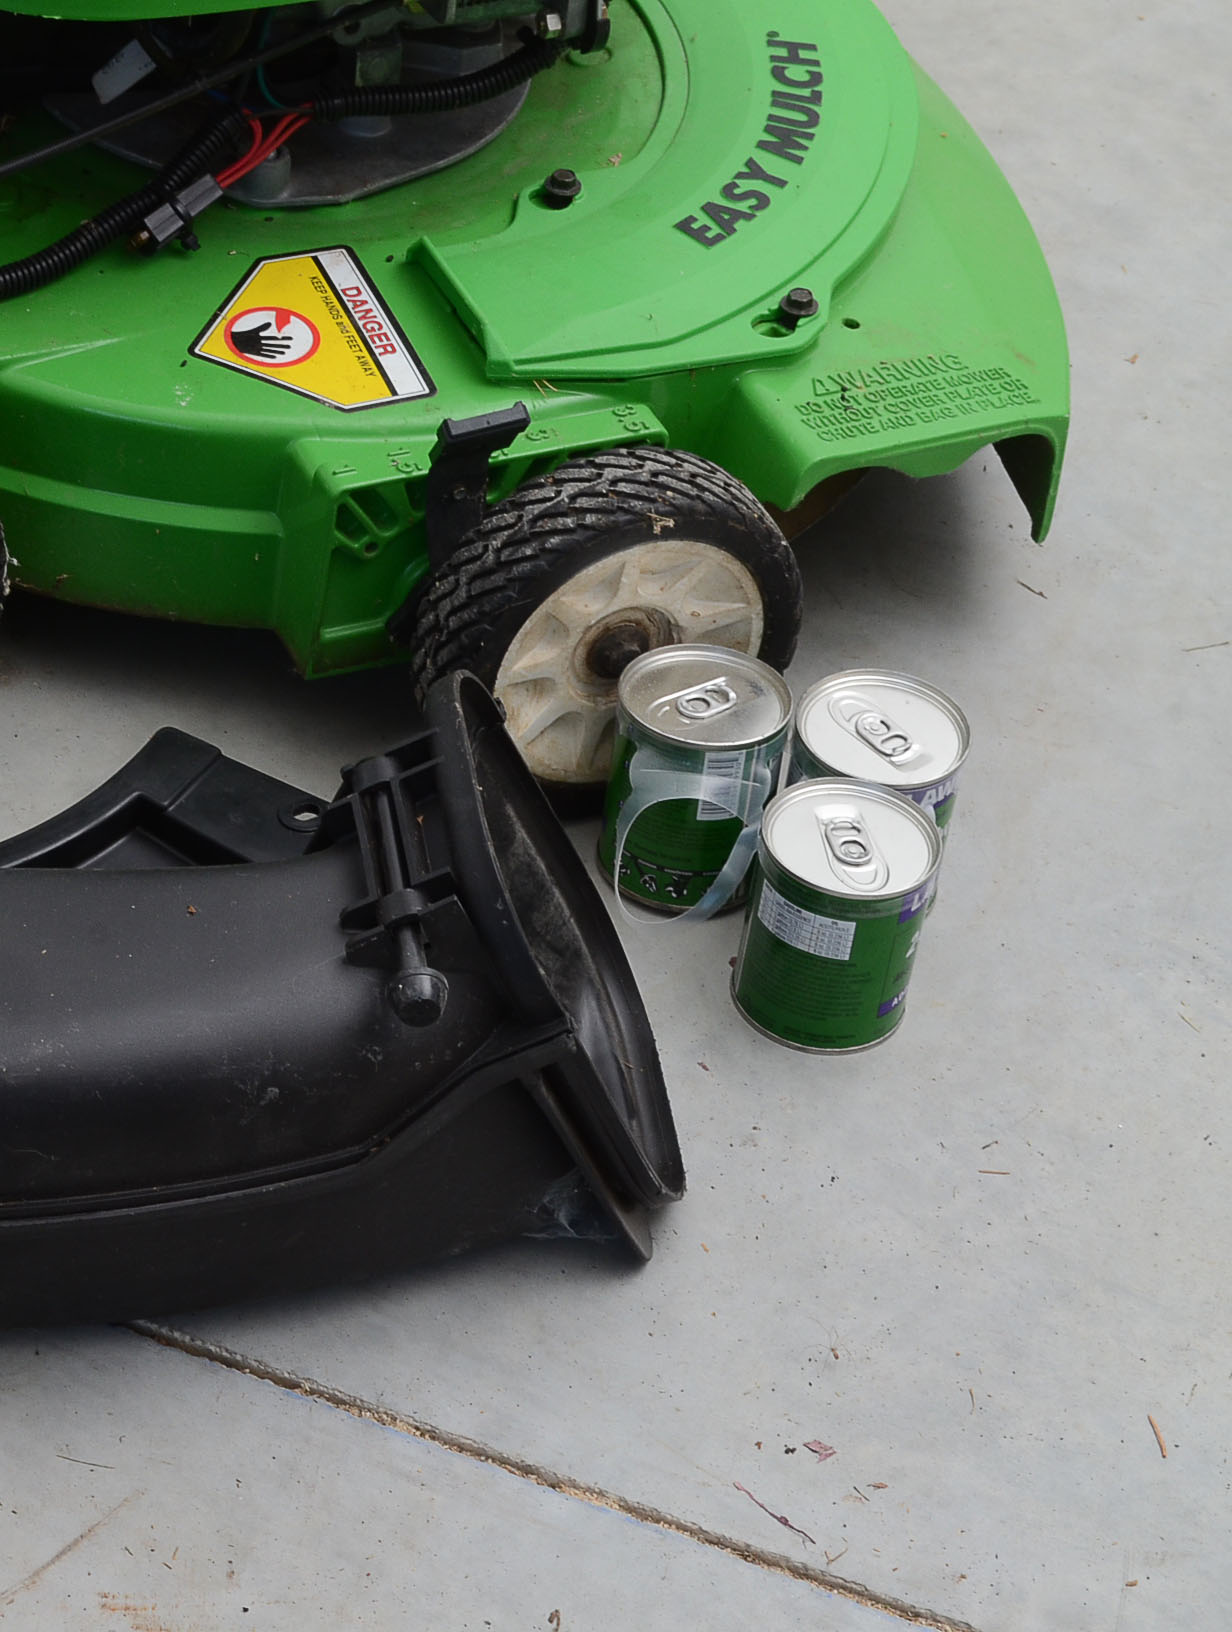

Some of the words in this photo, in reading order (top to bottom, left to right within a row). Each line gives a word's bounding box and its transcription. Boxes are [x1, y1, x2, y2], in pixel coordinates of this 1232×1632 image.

[672, 156, 789, 250] EASY
[754, 38, 824, 166] MULCH
[309, 275, 328, 295] KEEP
[321, 295, 343, 320] HANDS
[336, 321, 351, 335] and
[344, 334, 363, 353] FEET
[355, 355, 376, 377] AWAY
[340, 286, 397, 357] DANGER
[794, 401, 824, 416] DO
[824, 394, 862, 411] NOT
[864, 379, 946, 403] OPERATE
[942, 367, 1011, 388] MOWER
[828, 354, 969, 391] WARNING
[613, 403, 650, 433] 3.5
[801, 405, 882, 430] WITHOUT
[884, 394, 947, 414] COVER
[943, 383, 1002, 402] PLATE
[999, 379, 1028, 393] OR
[817, 422, 880, 442] CHUTE
[879, 415, 916, 431] AND
[915, 407, 957, 423] BAG
[955, 402, 979, 415] IN
